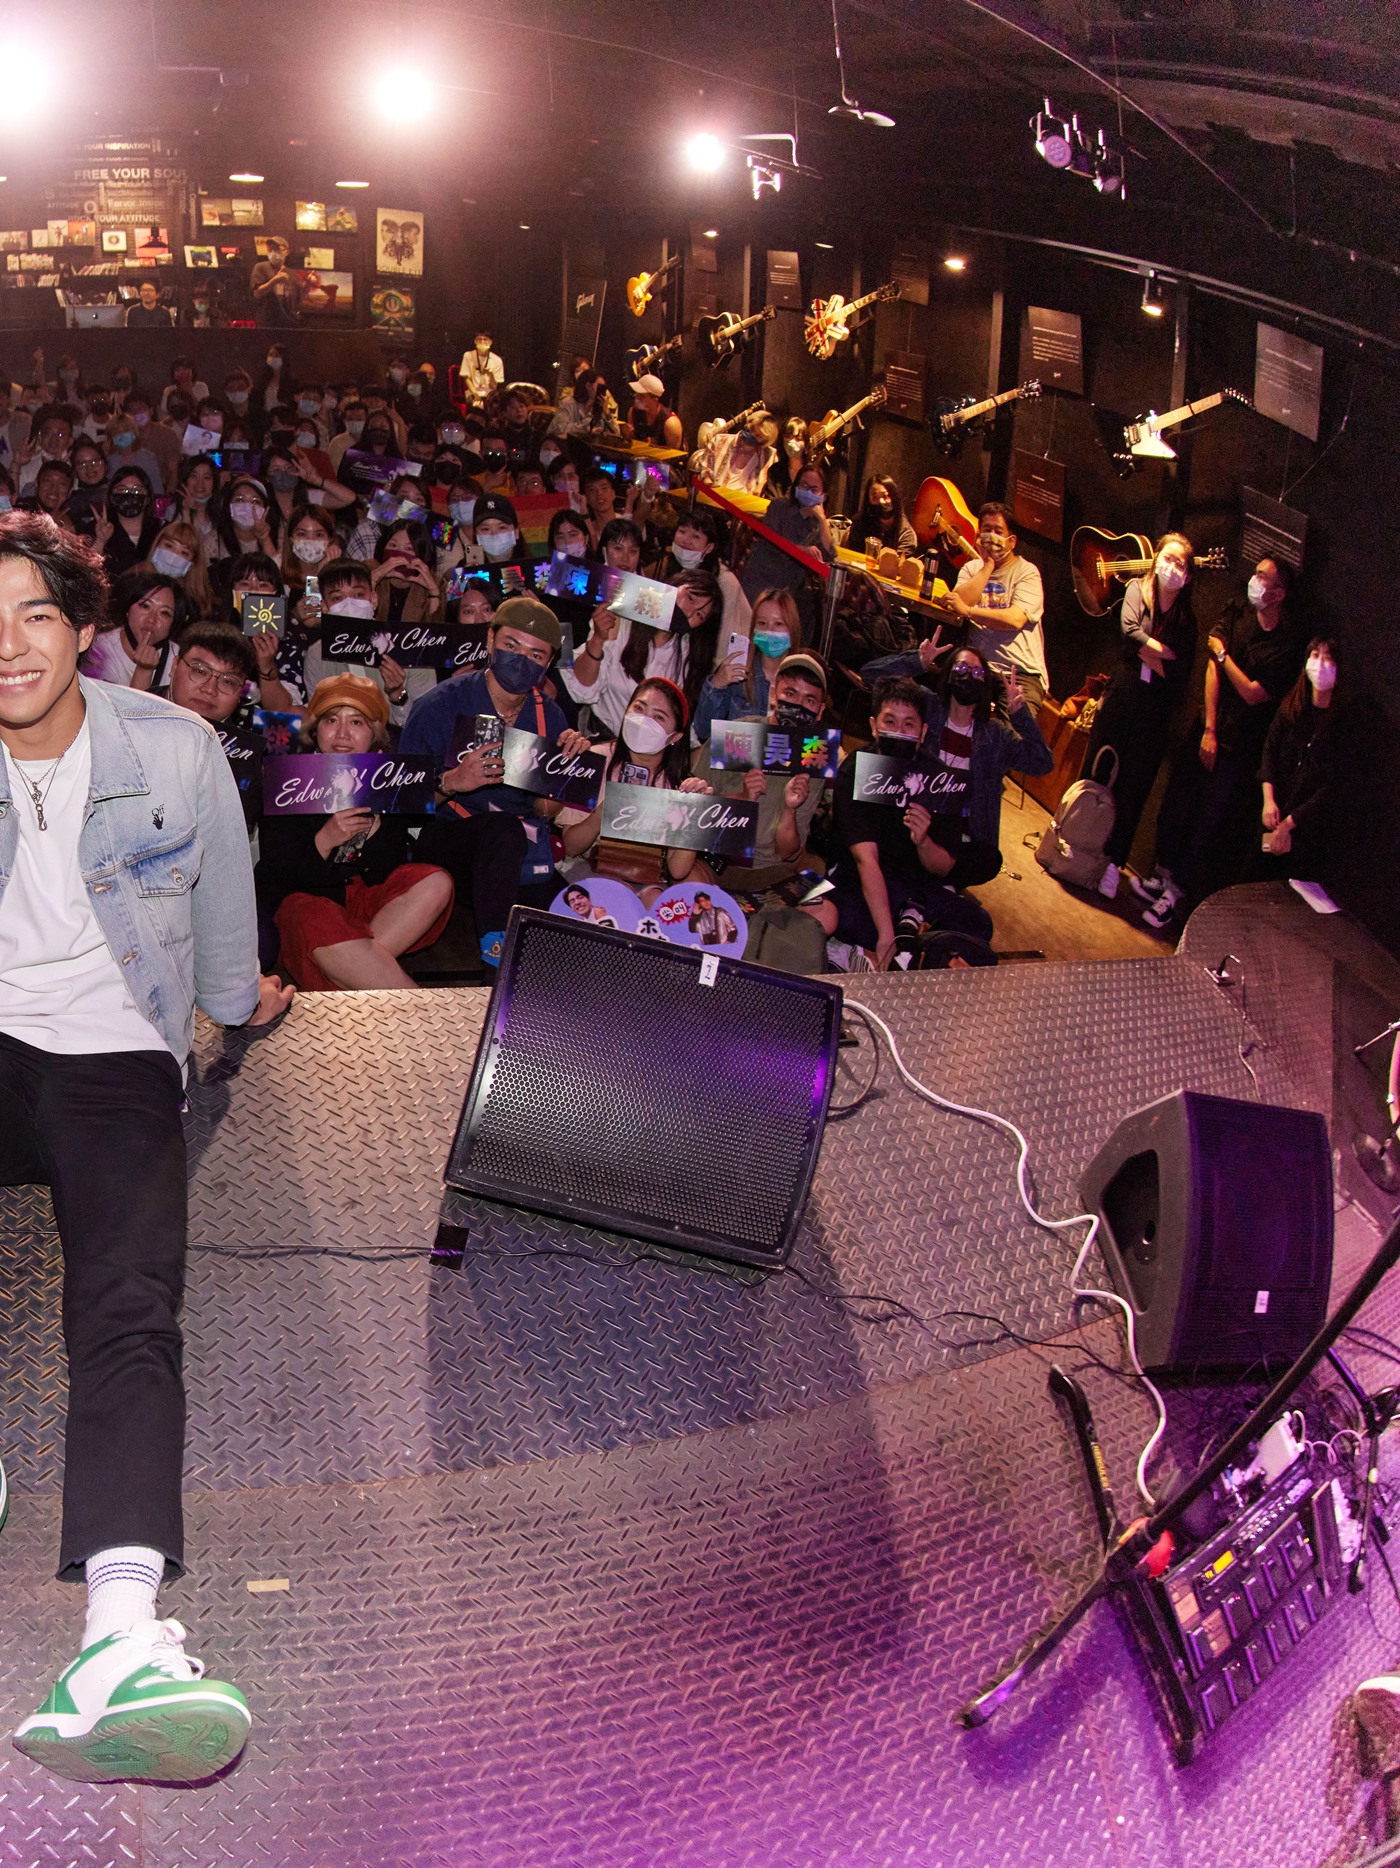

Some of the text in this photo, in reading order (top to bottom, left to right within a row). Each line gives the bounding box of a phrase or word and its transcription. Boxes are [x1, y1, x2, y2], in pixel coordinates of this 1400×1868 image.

[74, 170, 109, 181] FREE
[112, 168, 150, 180] YOUR
[400, 627, 448, 650] Chen
[722, 729, 830, 769] 陳昊森
[370, 760, 427, 791] Chen
[545, 752, 597, 779] Chen
[929, 771, 968, 795] Chen
[697, 803, 750, 830] Chen
